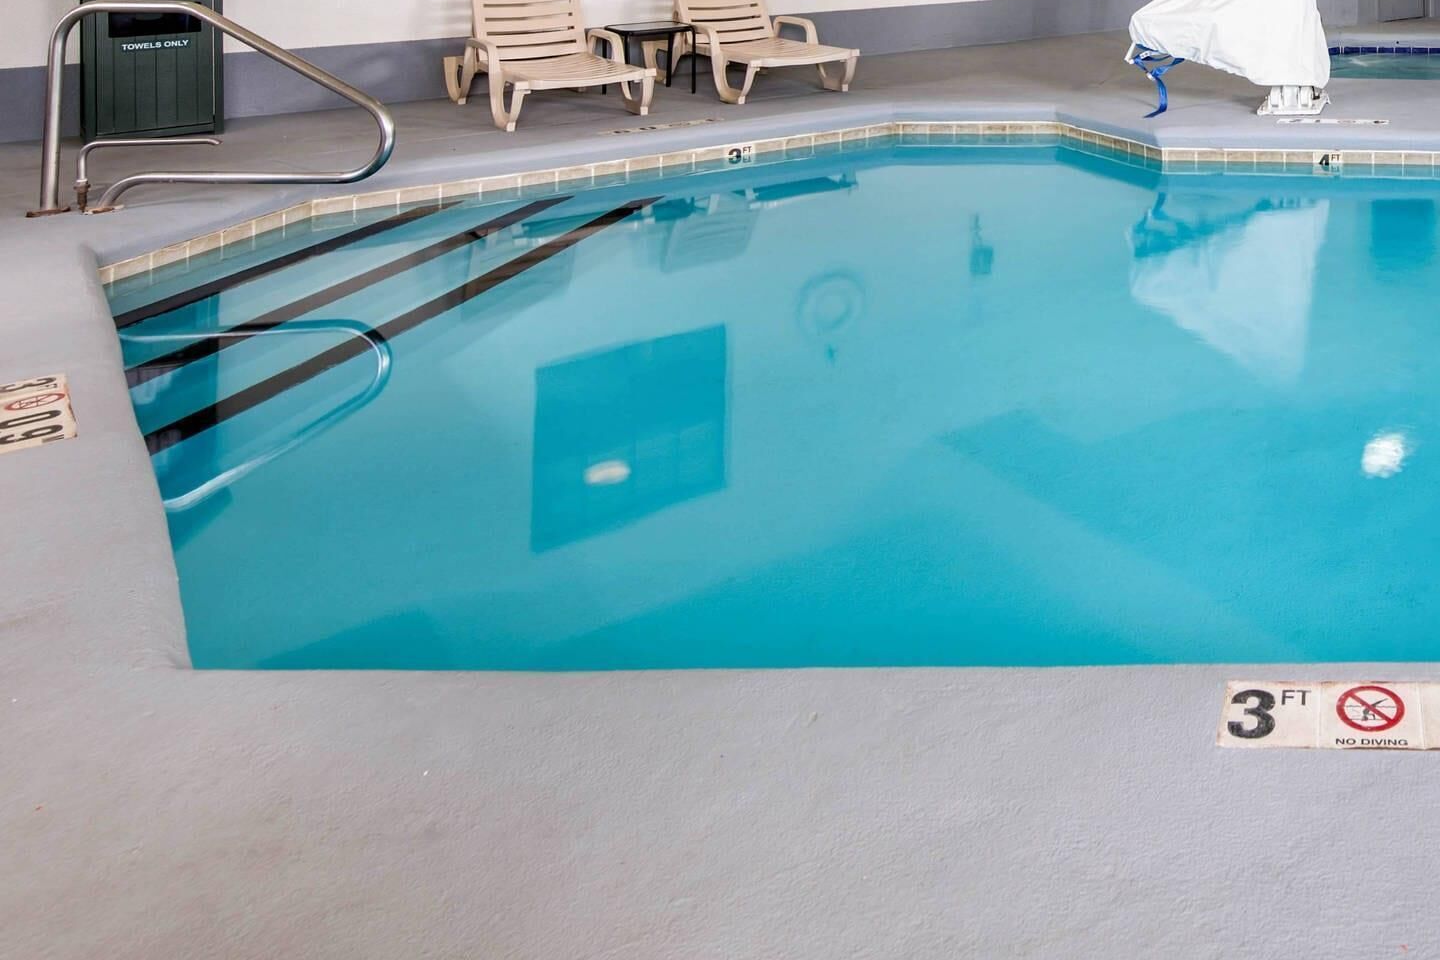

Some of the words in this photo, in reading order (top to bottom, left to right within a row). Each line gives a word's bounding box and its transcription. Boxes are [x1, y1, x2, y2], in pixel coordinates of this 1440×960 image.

[121, 41, 162, 51] TOWELS
[163, 39, 189, 47] ONLY
[0, 377, 57, 393] 3
[1228, 689, 1276, 739] 3
[1281, 690, 1311, 706] FT
[1335, 738, 1356, 746] NO
[1360, 738, 1409, 746] DIVING
